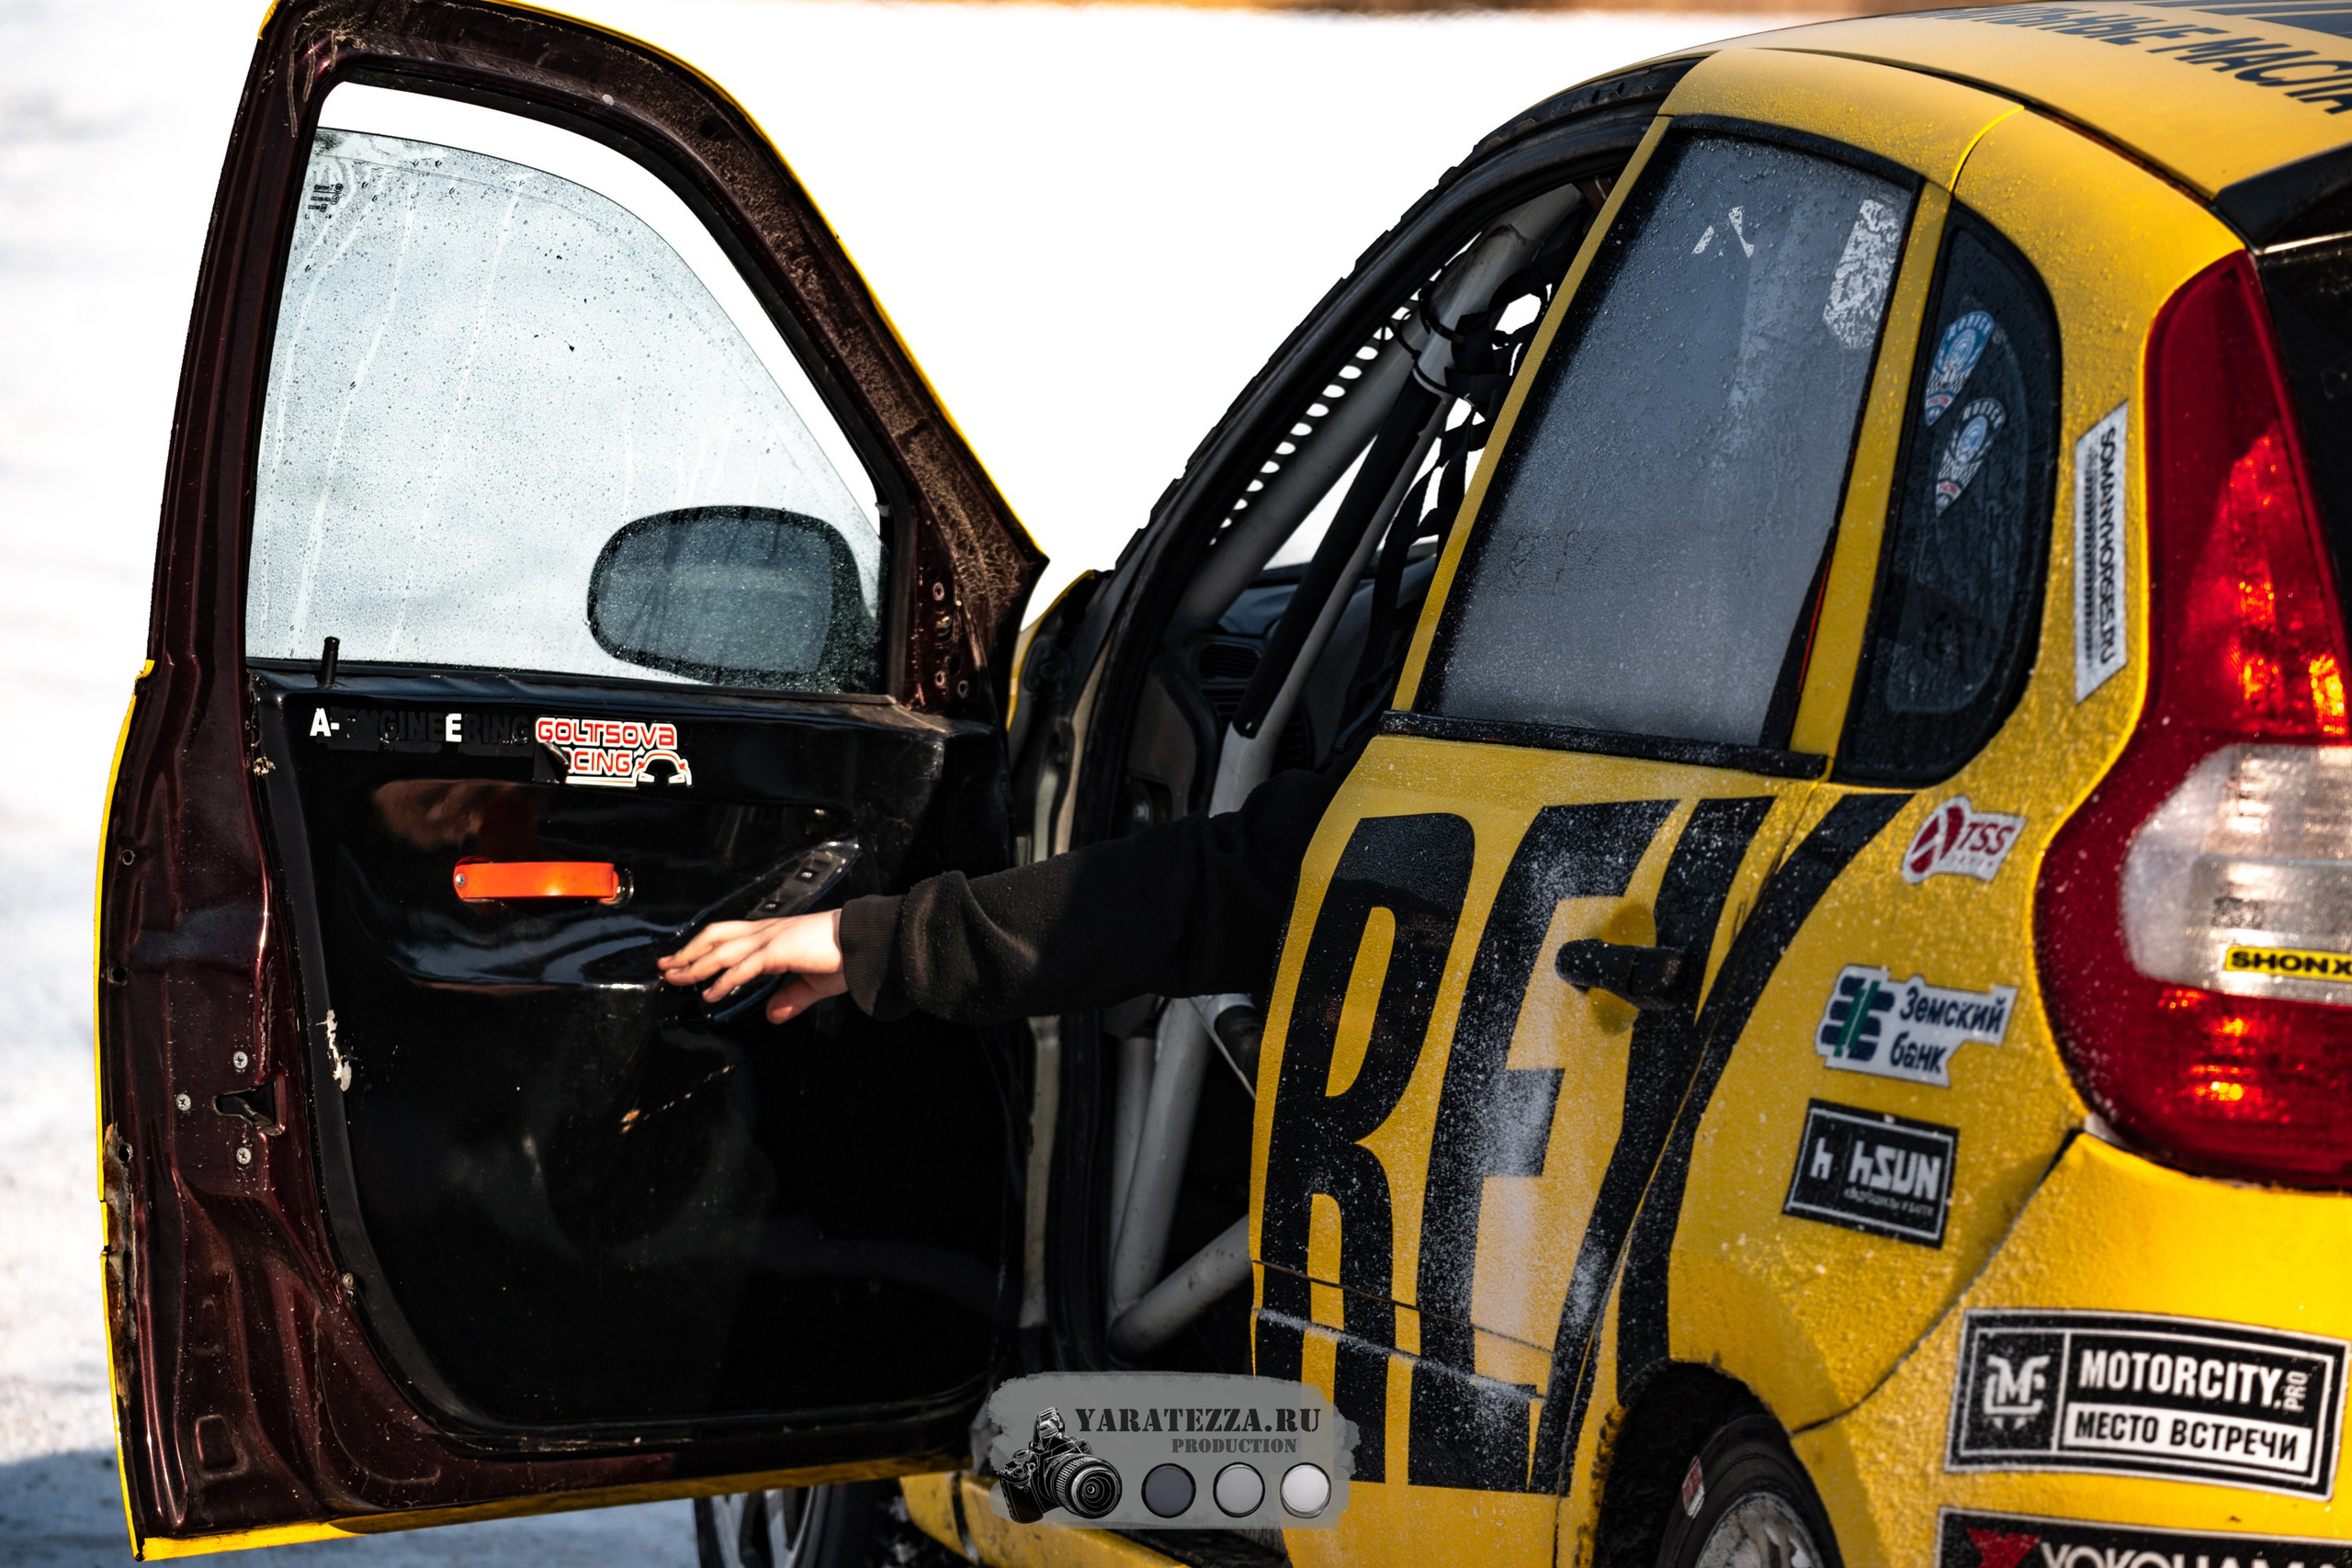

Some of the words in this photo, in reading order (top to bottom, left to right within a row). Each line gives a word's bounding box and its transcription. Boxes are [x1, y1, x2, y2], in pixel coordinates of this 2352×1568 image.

[2098, 425, 2117, 665] SOMANYHORSES.RU
[1957, 820, 2016, 856] TSS
[1899, 985, 2008, 1034] Земский
[1889, 1031, 1947, 1075] банк
[2074, 1410, 2158, 1444] МЕСТО
[2169, 1417, 2299, 1462] ВСТРЕЧИ
